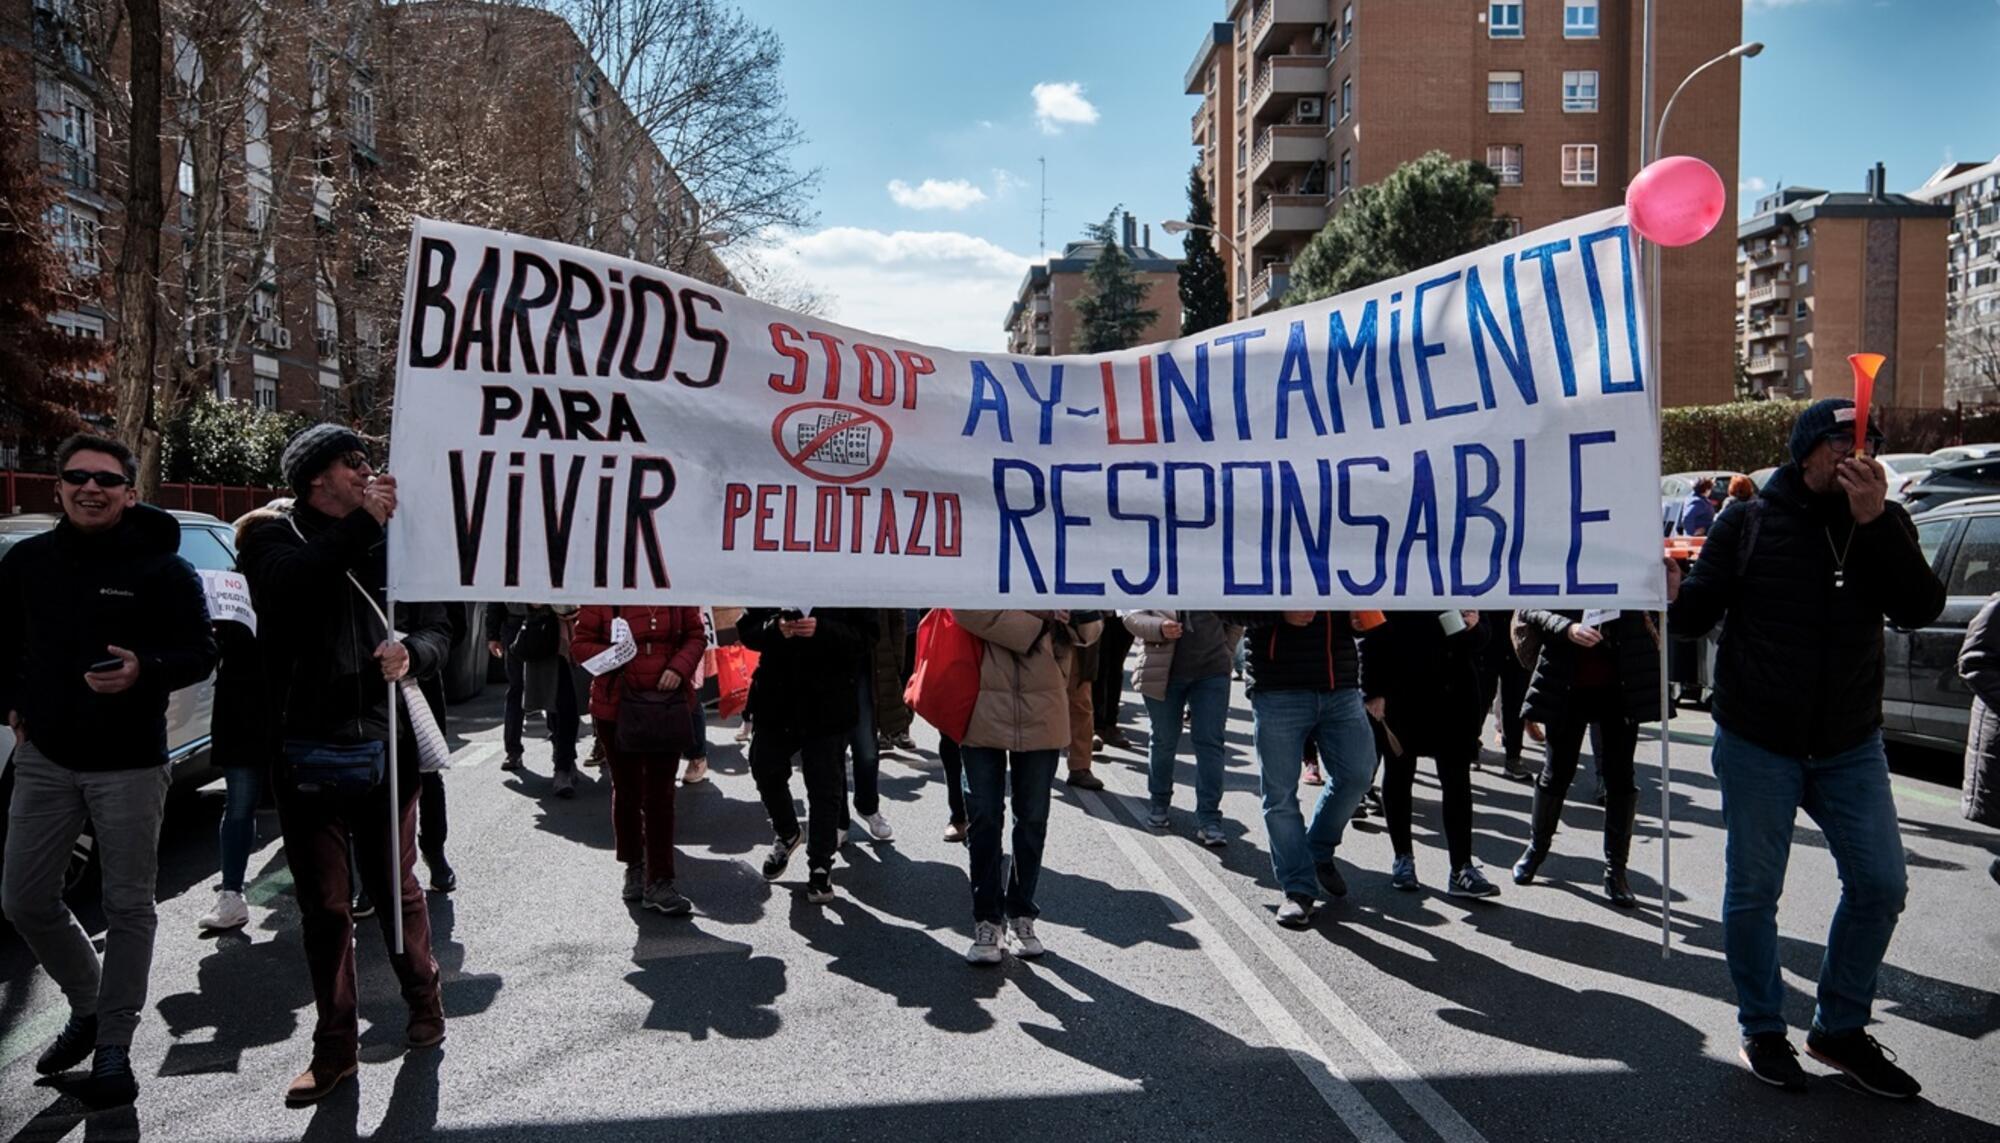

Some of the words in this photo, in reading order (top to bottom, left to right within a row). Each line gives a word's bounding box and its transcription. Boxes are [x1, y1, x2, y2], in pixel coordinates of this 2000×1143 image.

[768, 322, 936, 410] STOP
[479, 384, 646, 442] PARA
[721, 482, 962, 557] PELOTAZO
[993, 430, 1618, 597] RESPONSABLE
[224, 579, 242, 590] NO
